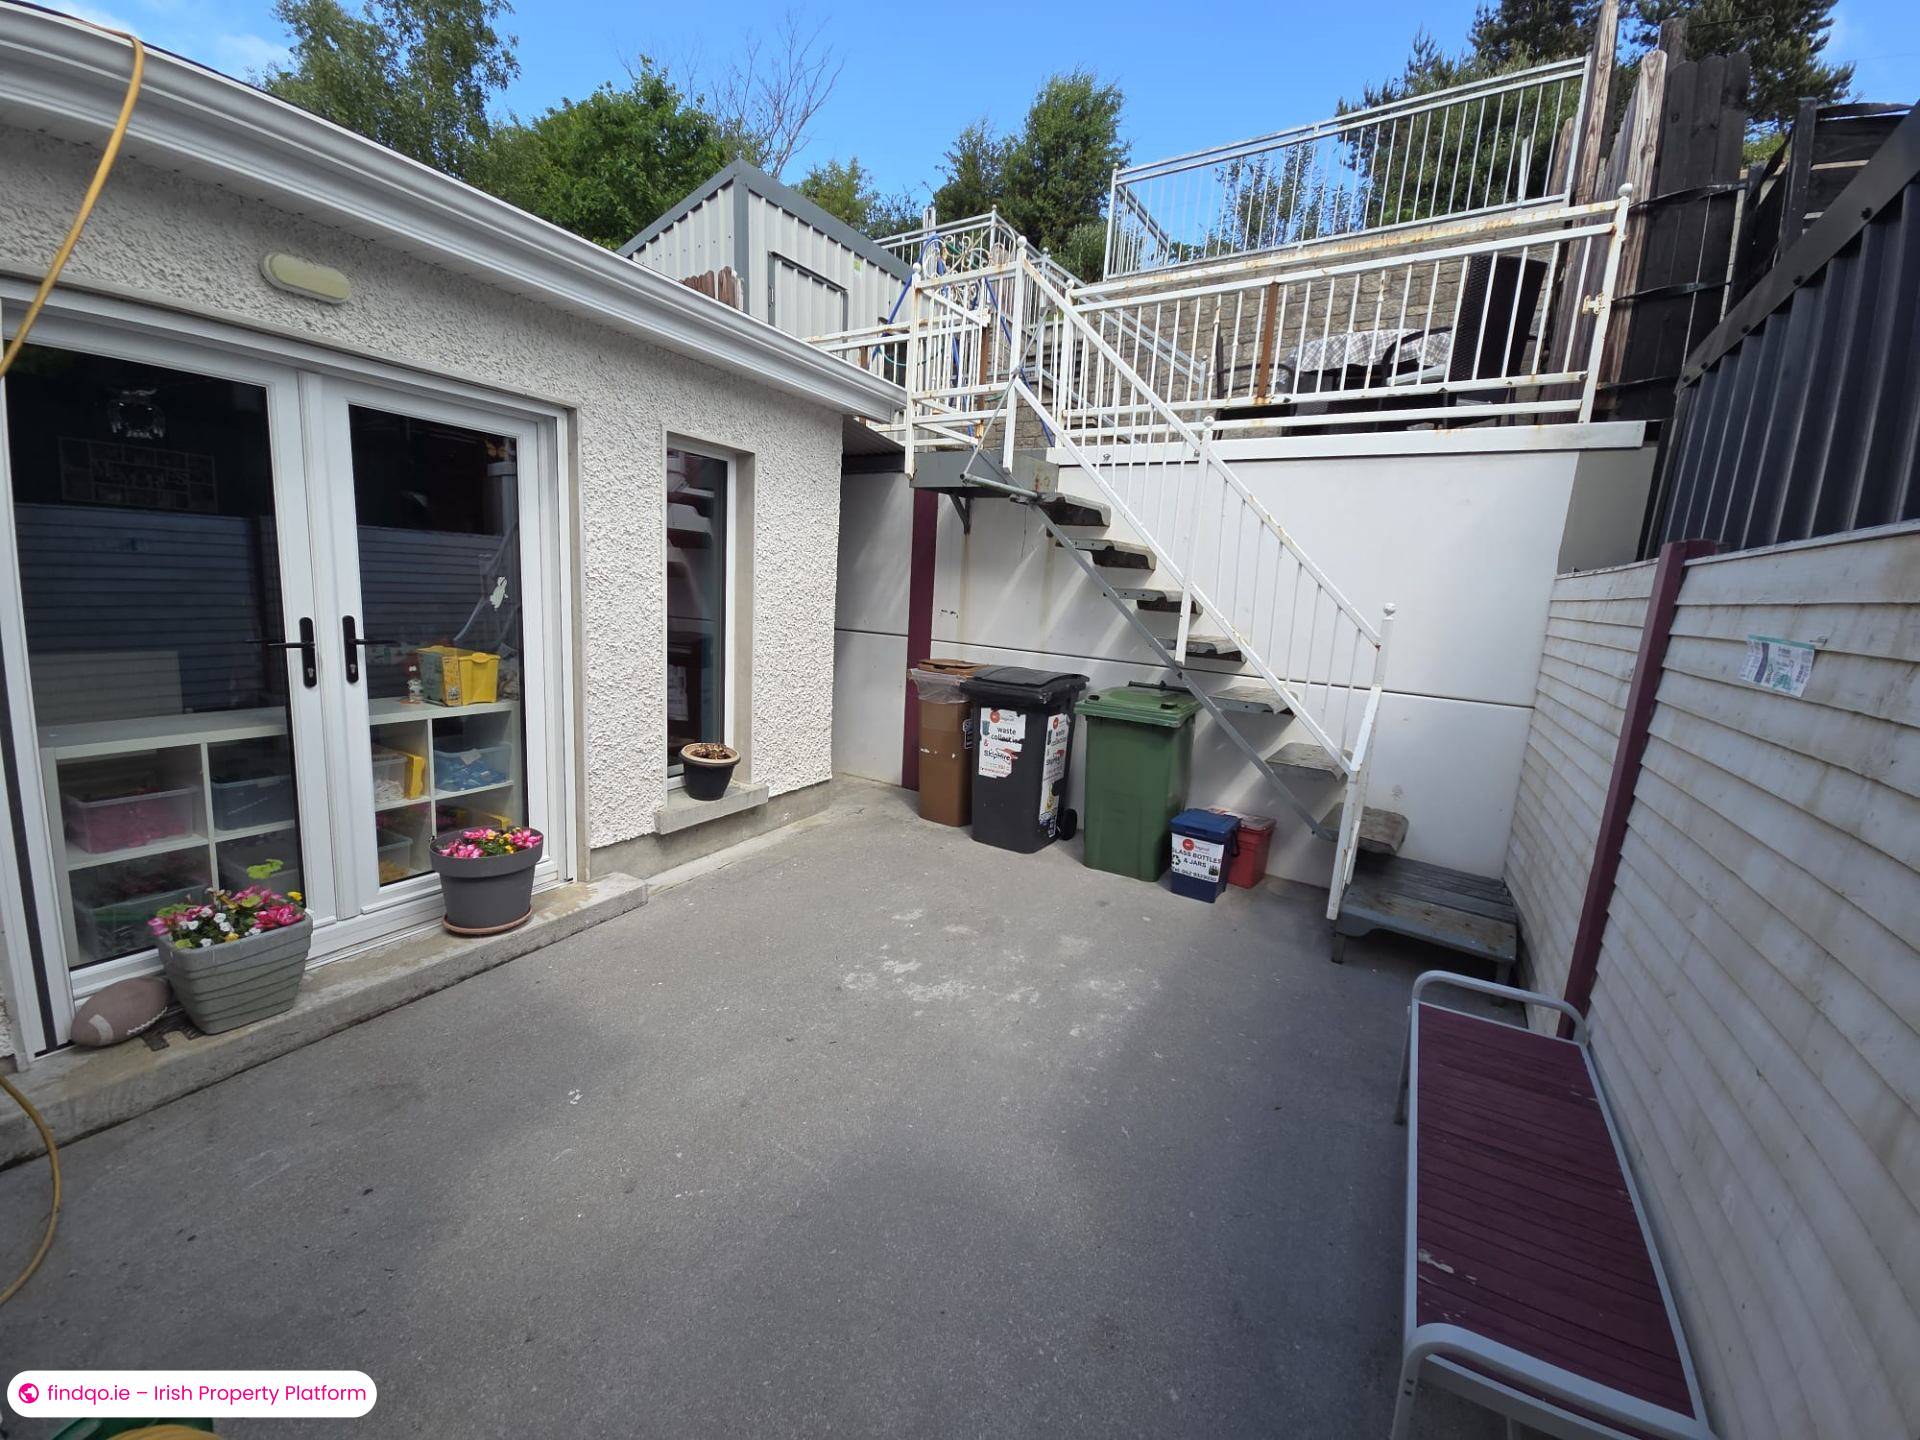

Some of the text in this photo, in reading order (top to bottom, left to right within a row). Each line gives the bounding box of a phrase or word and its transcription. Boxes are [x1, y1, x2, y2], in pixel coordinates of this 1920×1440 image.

[997, 727, 1017, 736] waste
[1192, 853, 1222, 864] BOTTLES
[1189, 859, 1207, 868] JARS
